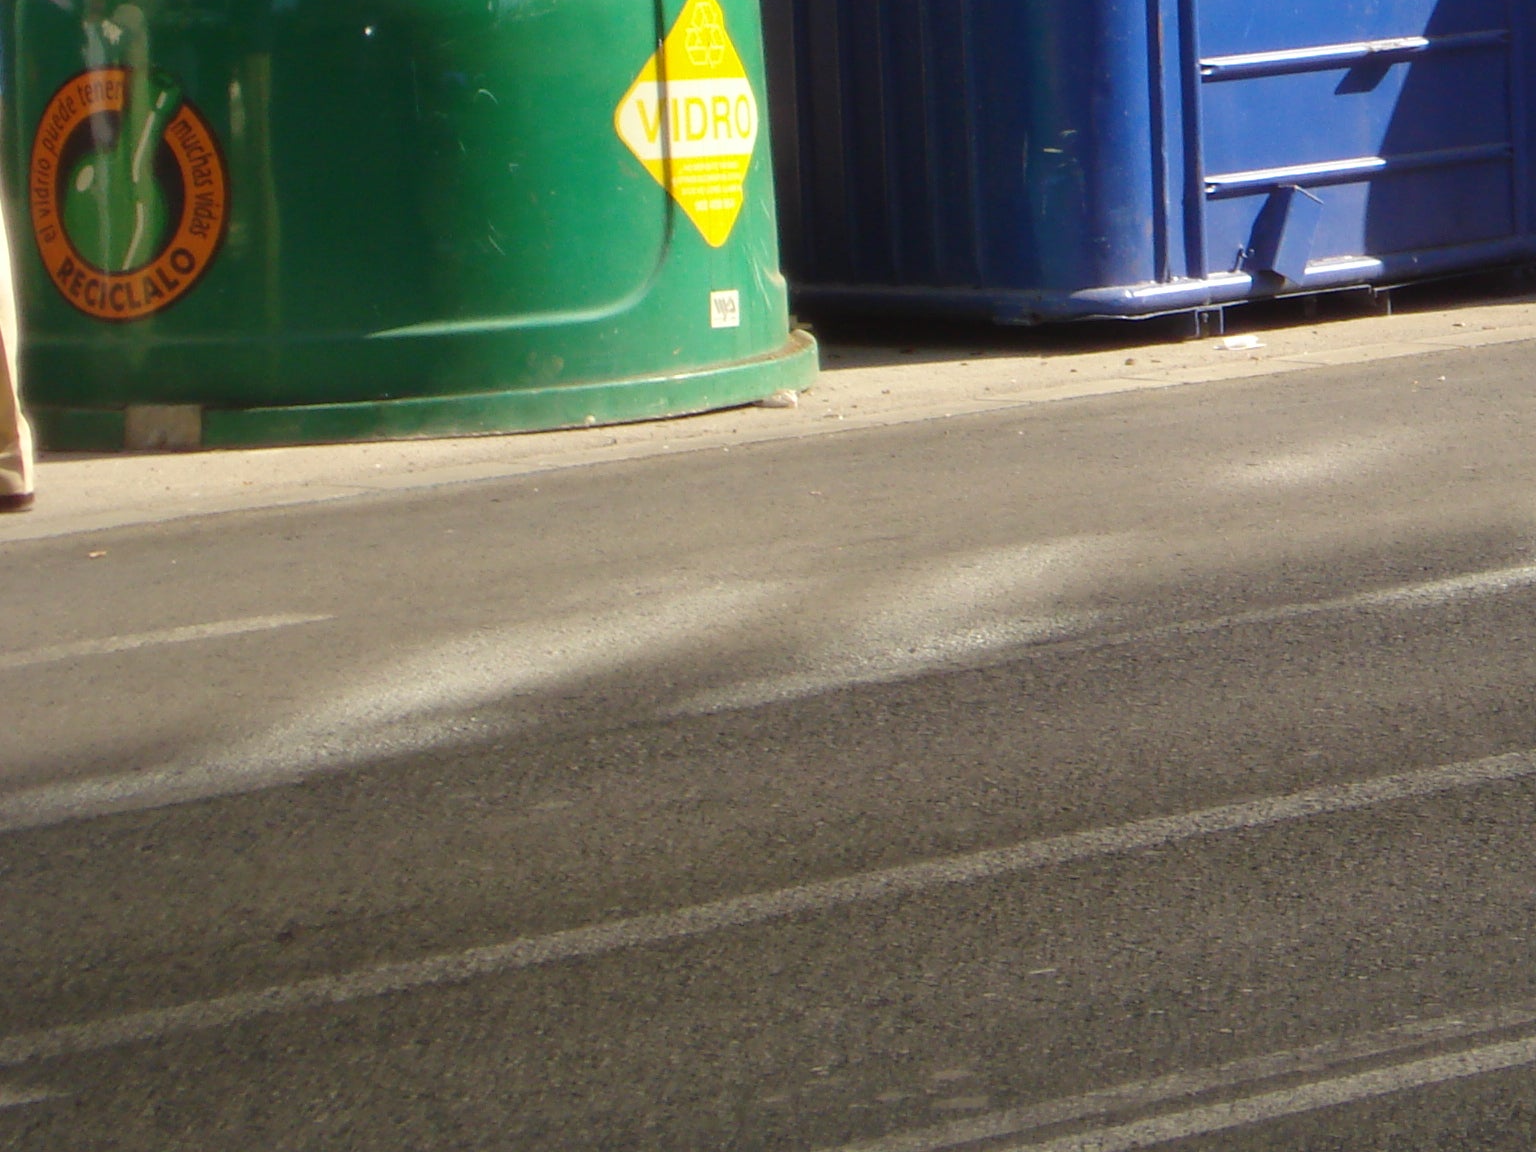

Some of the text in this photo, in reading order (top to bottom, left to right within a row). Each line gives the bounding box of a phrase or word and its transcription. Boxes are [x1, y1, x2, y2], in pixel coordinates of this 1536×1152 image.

[32, 158, 50, 218] vidrio
[41, 95, 76, 154] puede
[635, 93, 752, 145] VIDRO
[170, 118, 222, 240] muchas vidas
[57, 247, 196, 313] RECICLALO
